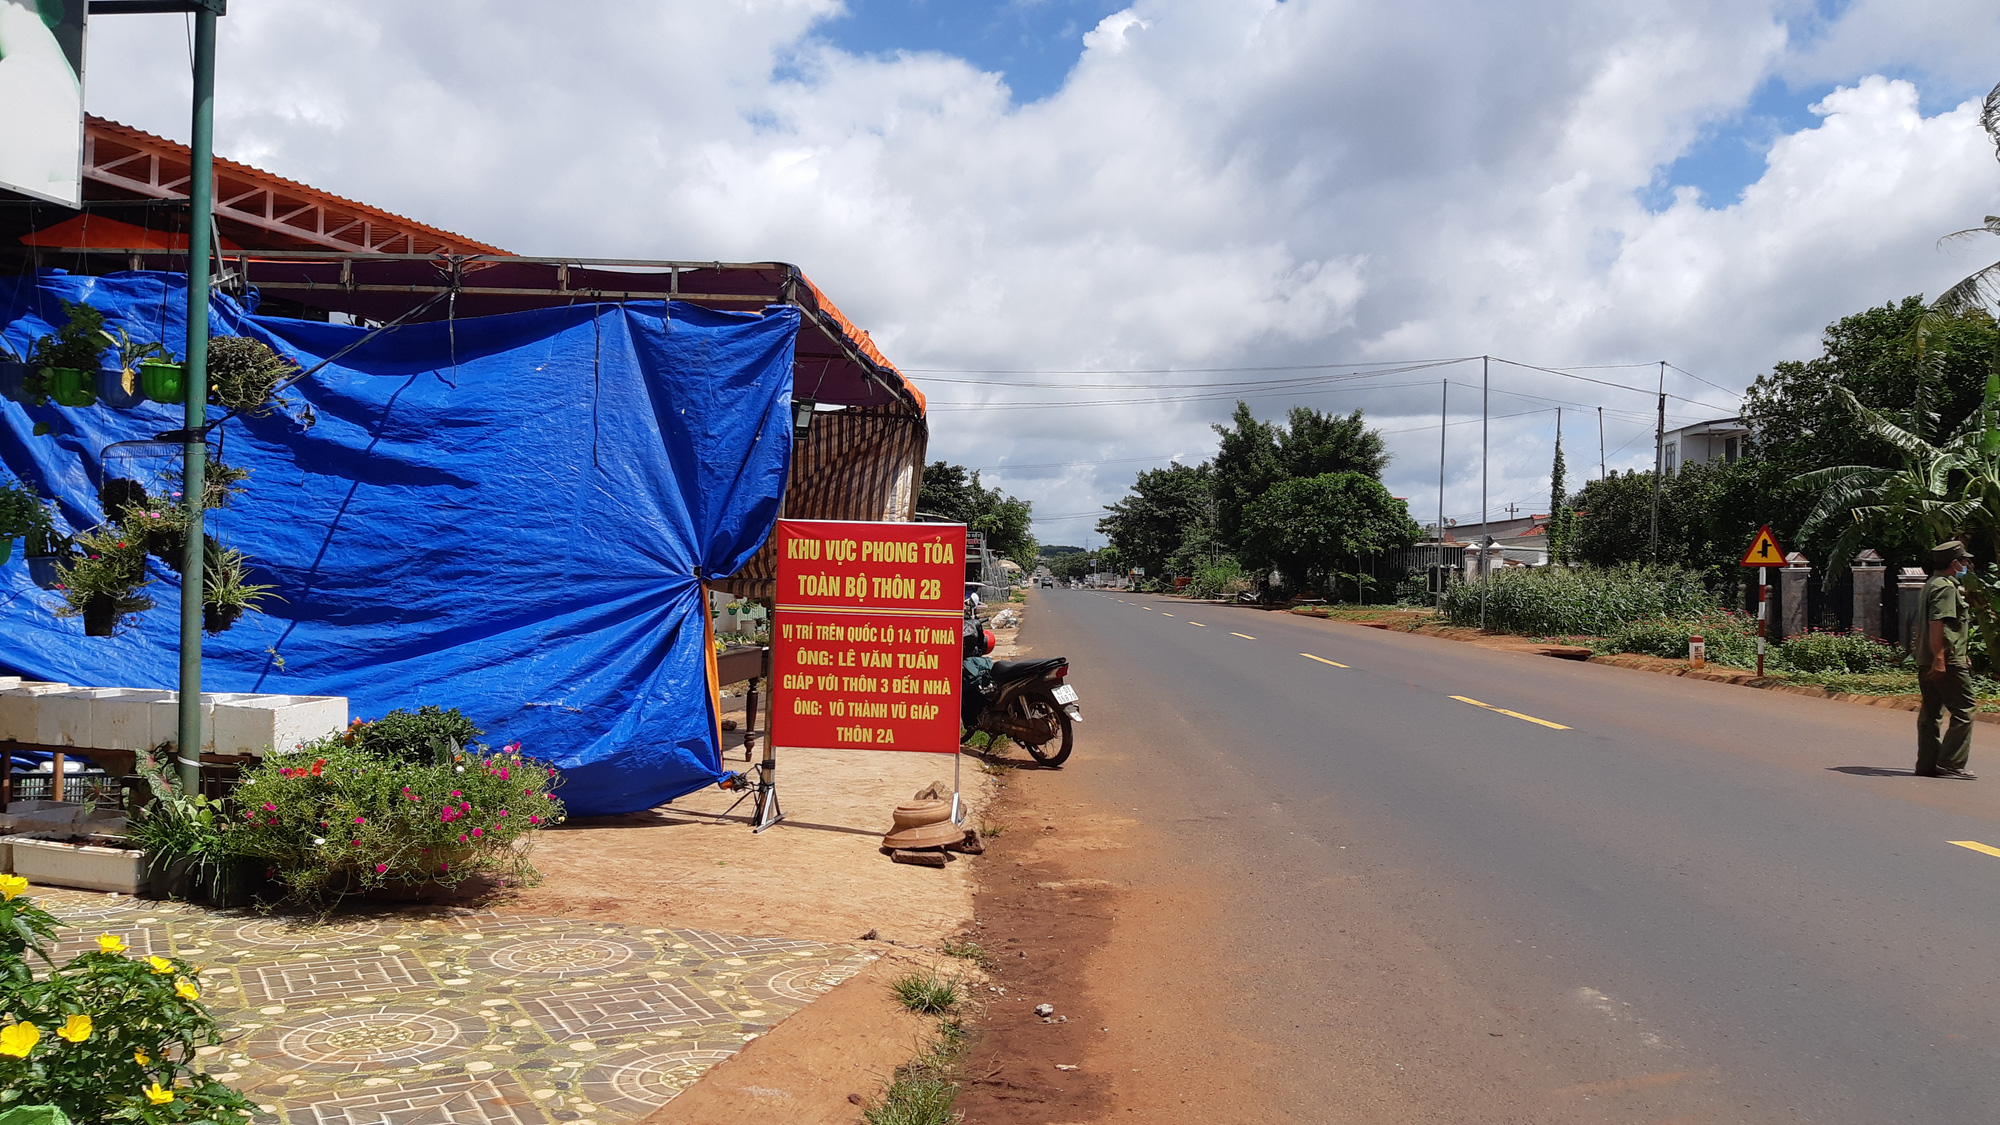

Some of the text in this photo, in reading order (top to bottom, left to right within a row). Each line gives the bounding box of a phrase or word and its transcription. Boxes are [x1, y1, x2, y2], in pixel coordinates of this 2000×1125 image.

[787, 536, 955, 566] KHU VỰC PHONG TỎA
[798, 571, 941, 602] TOÀN BỘ THÔN 2B
[782, 622, 956, 646] VỊ TRÍ TRÊN QUỐC LỘ 14 TỪ NHÀ
[796, 647, 939, 670] ÔNG: LÊ VĂN TUẤN
[783, 672, 952, 695] GIÁP VỚI THÔN 3 ĐẾN NHÀ
[793, 697, 940, 720] ÔNG: VÕ THÀNH VŨ GIÁP
[836, 724, 895, 744] THÔN 2A
